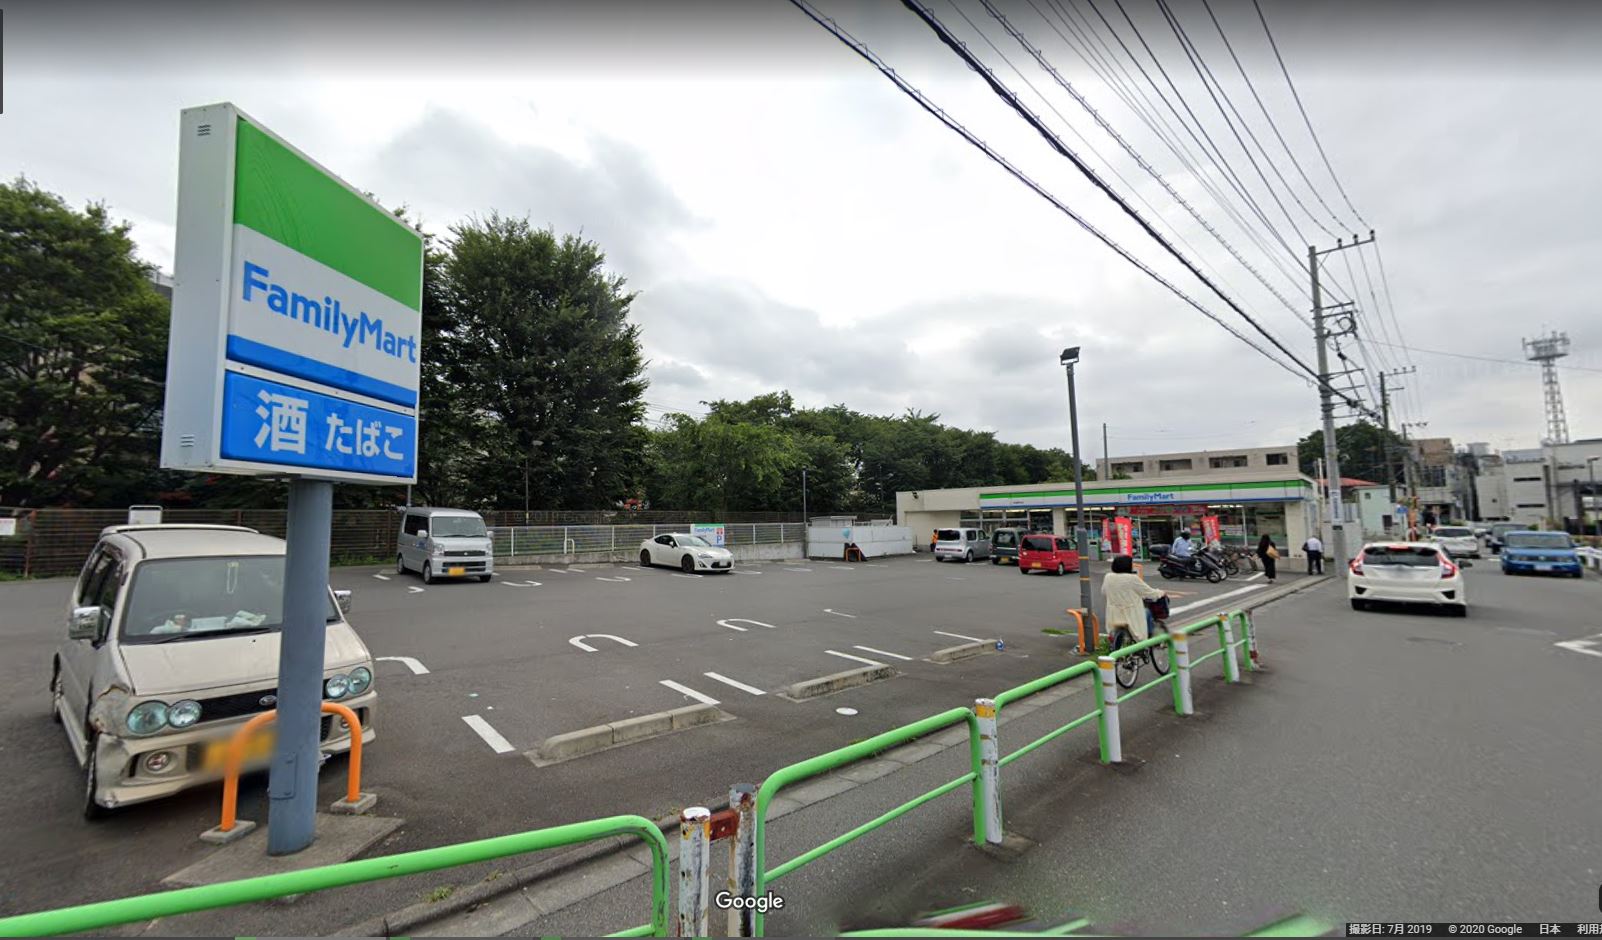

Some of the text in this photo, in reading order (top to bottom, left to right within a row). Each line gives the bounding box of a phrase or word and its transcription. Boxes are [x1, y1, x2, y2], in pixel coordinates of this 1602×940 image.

[243, 261, 417, 364] FamilyMart
[254, 389, 404, 461] 酒 たばこ
[1127, 492, 1174, 502] FamilyMart
